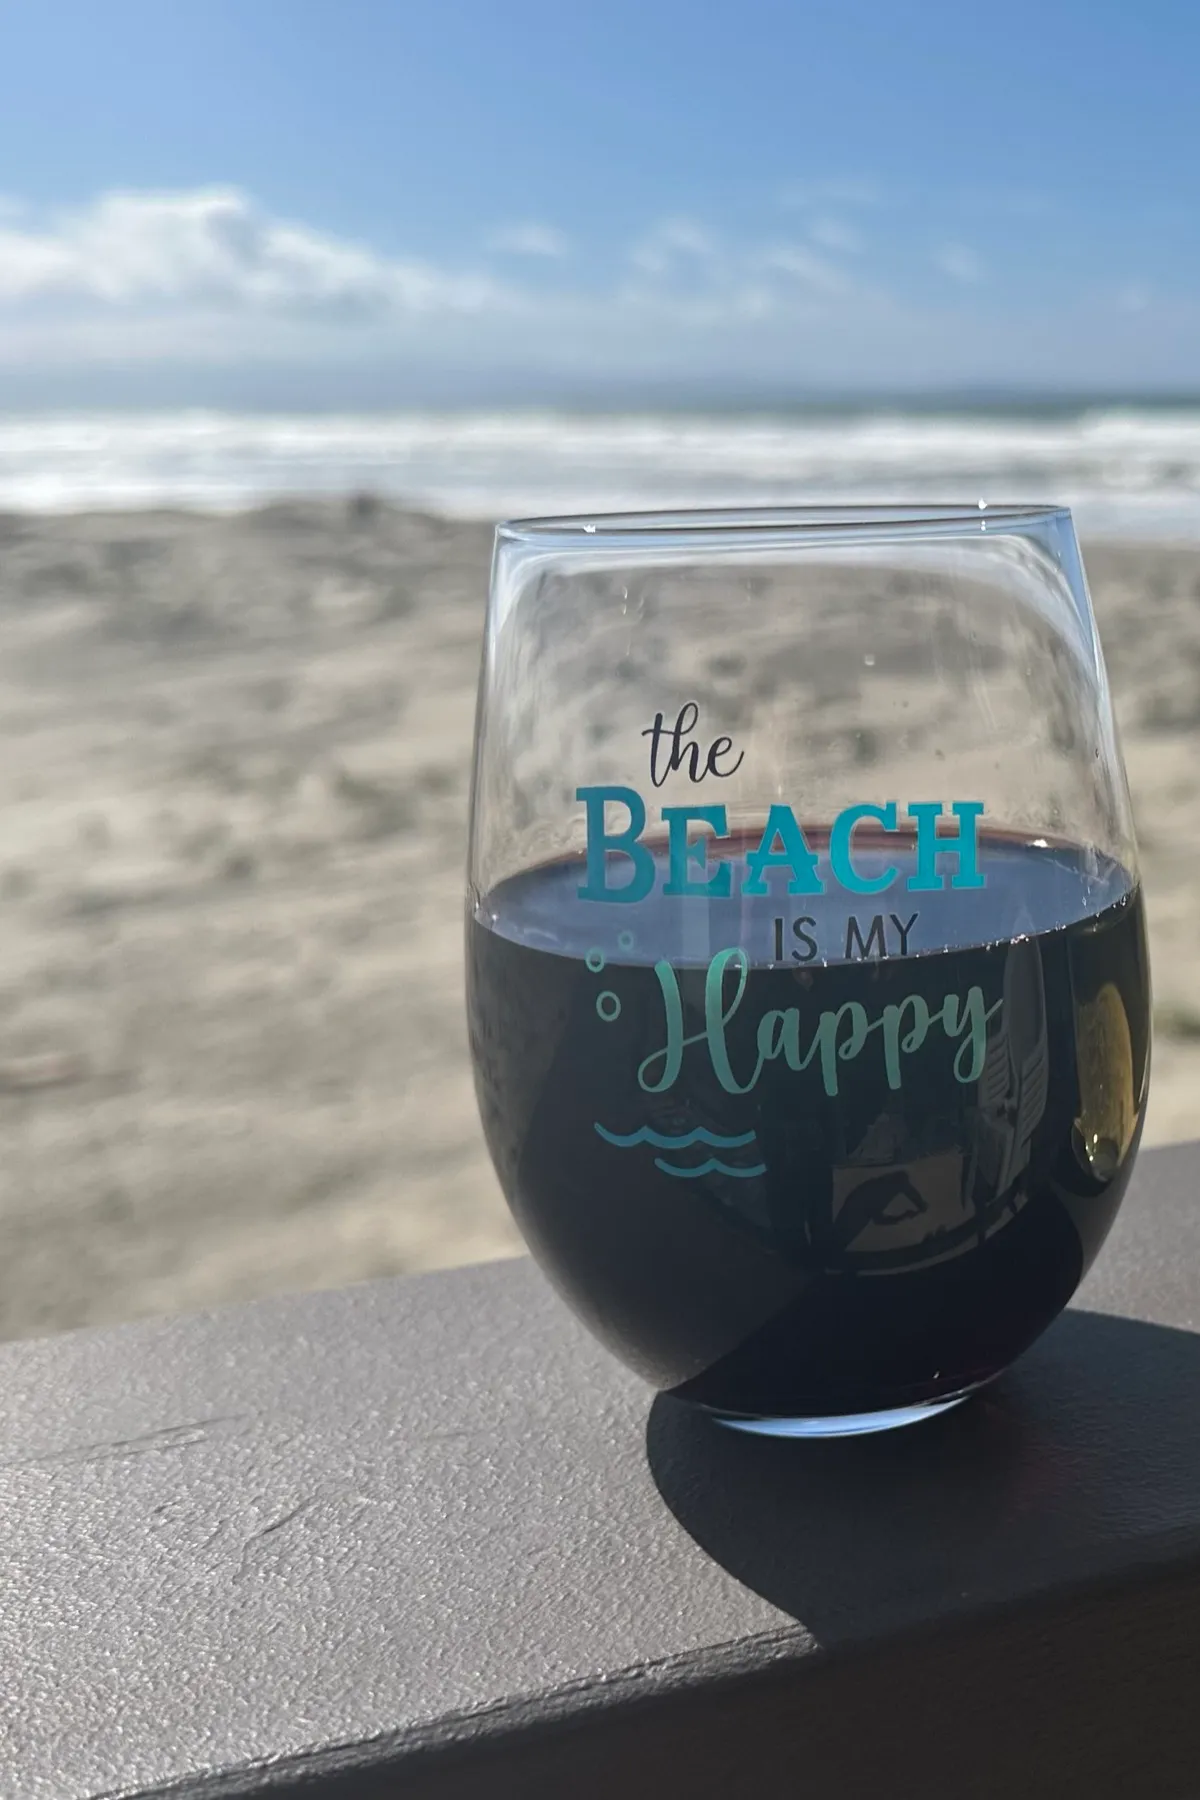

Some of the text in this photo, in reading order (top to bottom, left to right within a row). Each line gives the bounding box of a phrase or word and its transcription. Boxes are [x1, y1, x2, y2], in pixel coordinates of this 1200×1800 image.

[641, 701, 744, 787] the
[576, 786, 985, 903] BEACH
[775, 913, 919, 962] IS MY
[638, 947, 1003, 1096] Happy
